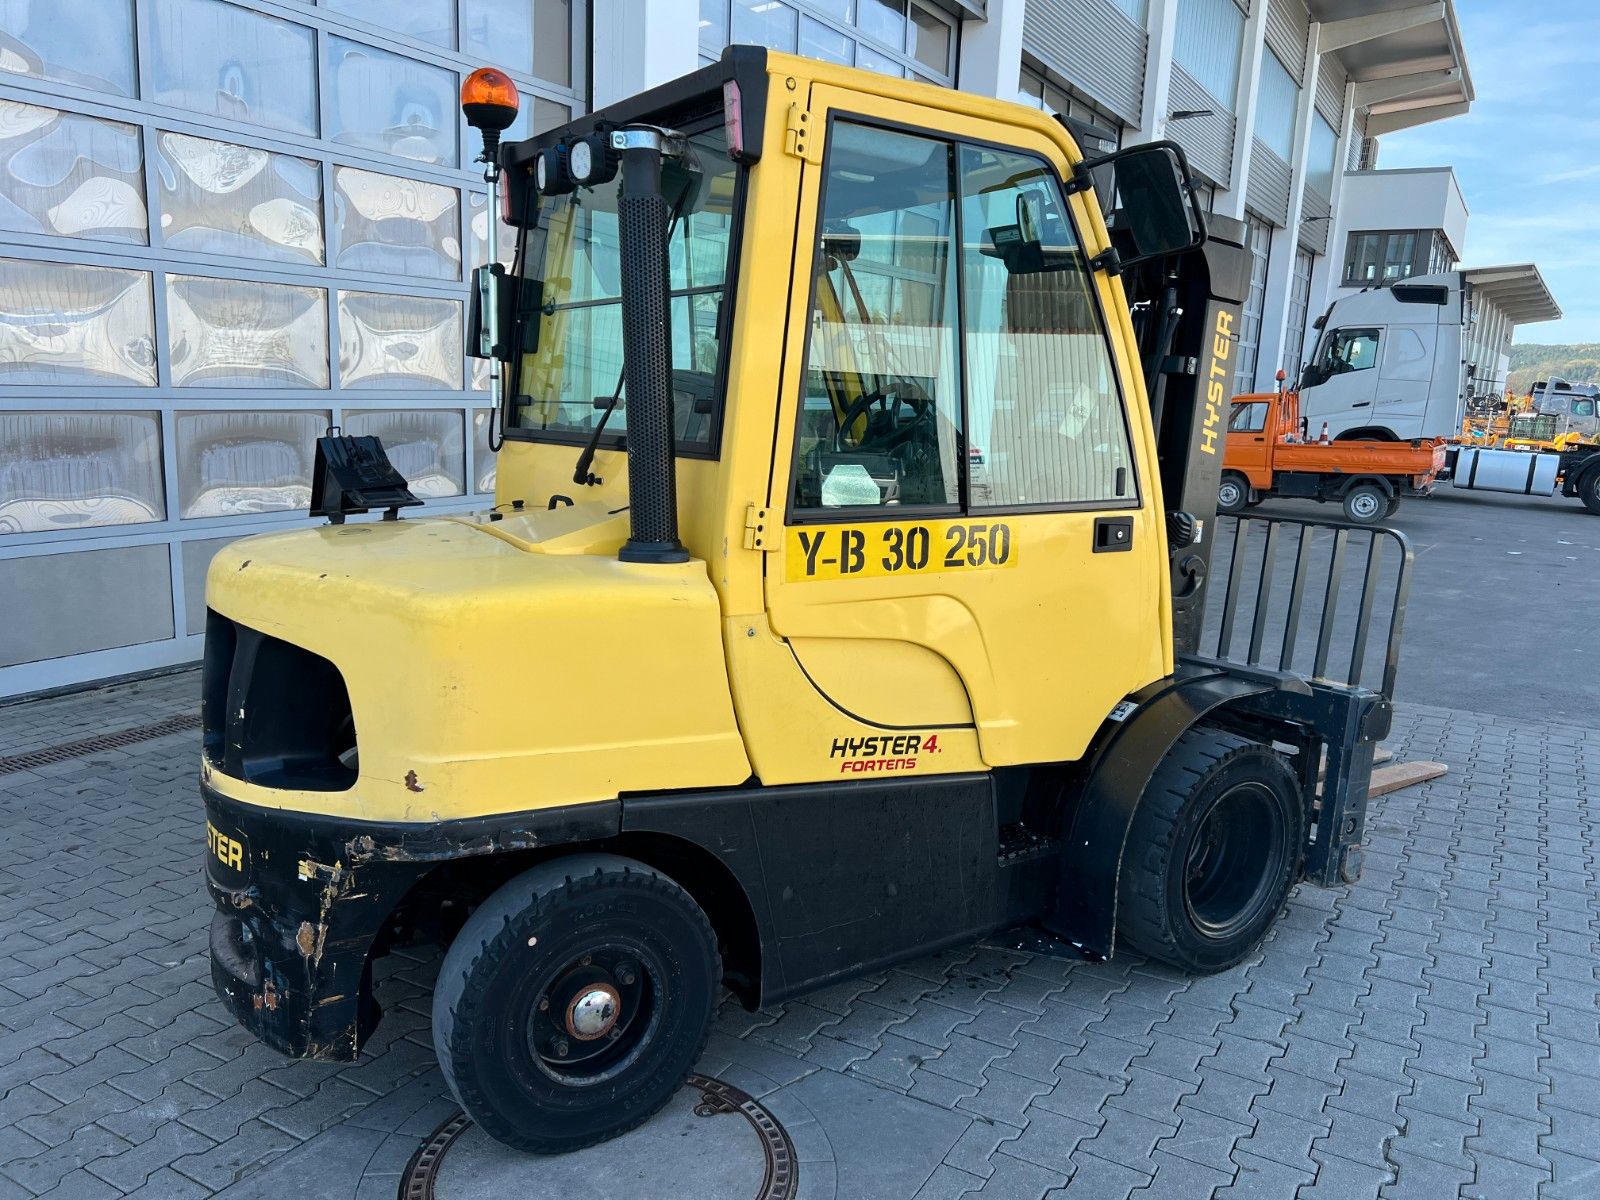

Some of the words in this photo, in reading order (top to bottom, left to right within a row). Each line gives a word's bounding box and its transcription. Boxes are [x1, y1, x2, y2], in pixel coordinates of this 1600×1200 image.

[1201, 310, 1233, 455] HYSTER
[798, 529, 866, 576] Y-B
[881, 526, 930, 572] 30
[943, 523, 1011, 567] 250
[830, 735, 922, 758] HYSTER
[840, 758, 917, 773] FORTENS
